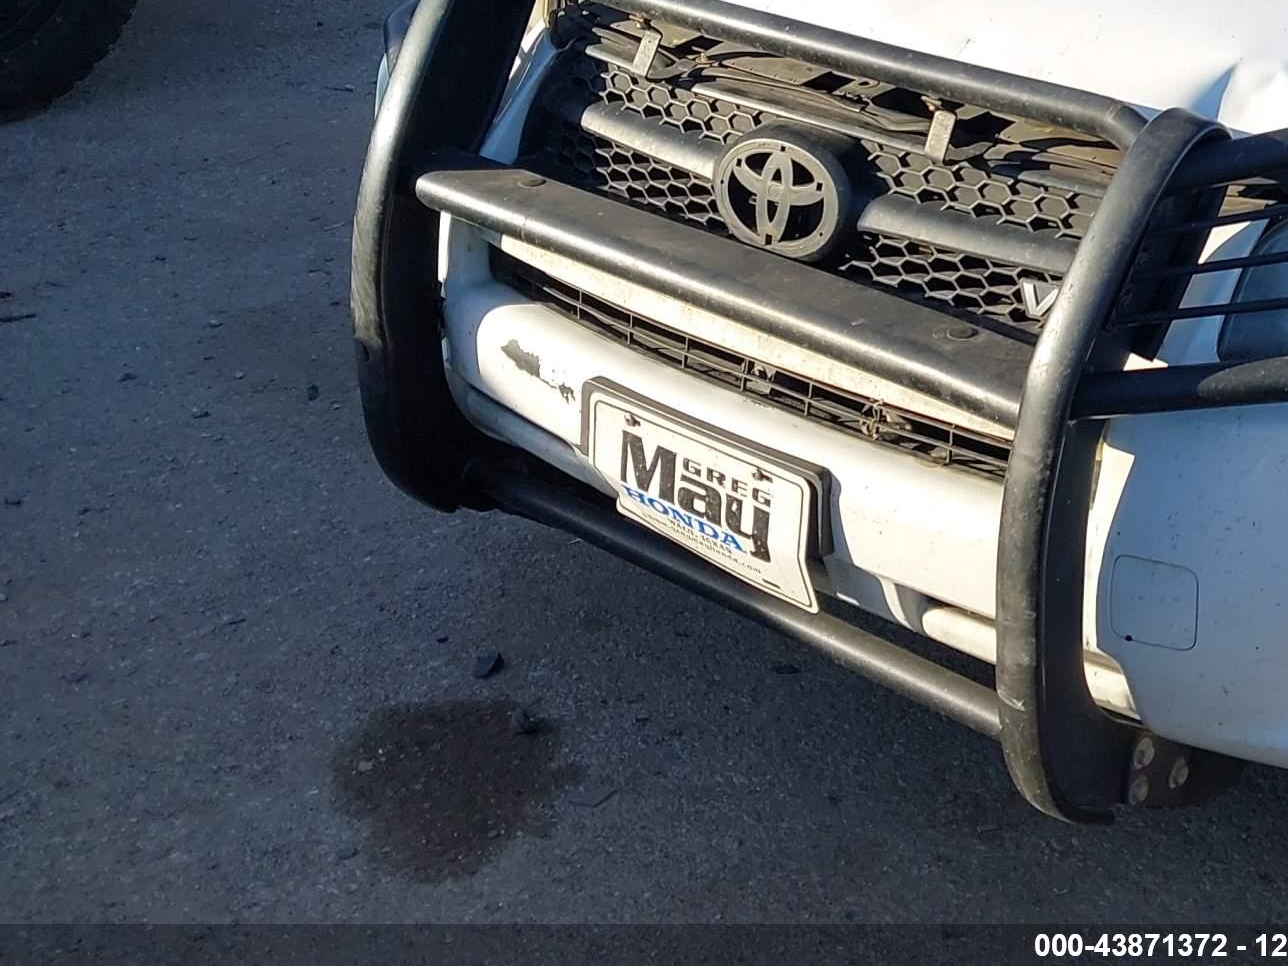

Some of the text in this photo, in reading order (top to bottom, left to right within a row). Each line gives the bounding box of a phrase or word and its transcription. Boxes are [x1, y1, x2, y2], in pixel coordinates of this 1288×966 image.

[620, 429, 772, 564] May
[682, 457, 772, 508] GREG
[622, 484, 748, 554] HONDA
